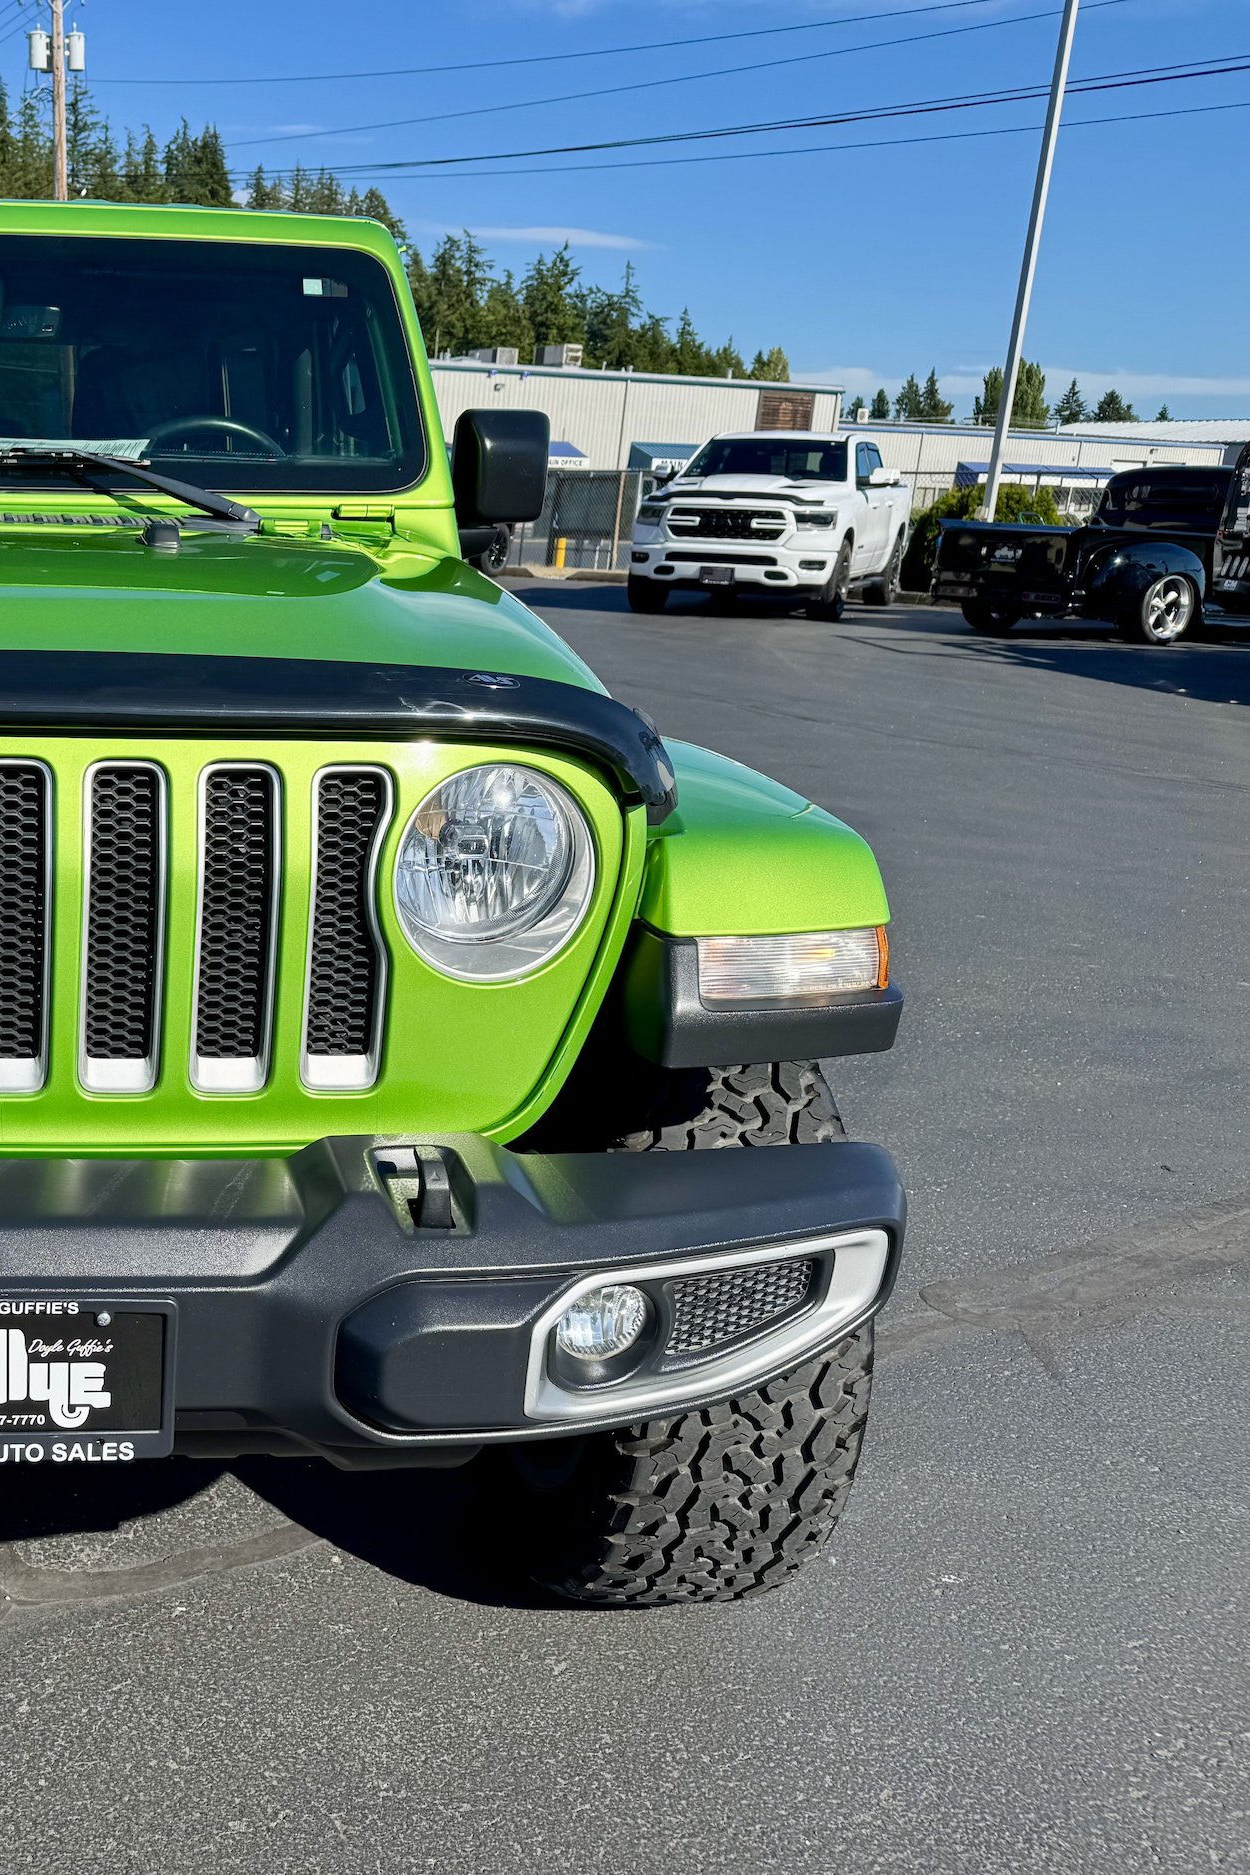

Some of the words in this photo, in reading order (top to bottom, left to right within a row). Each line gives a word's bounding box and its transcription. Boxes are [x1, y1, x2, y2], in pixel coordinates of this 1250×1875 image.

[28, 1338, 64, 1357] Doyle
[66, 1338, 114, 1357] Guffie's
[51, 1442, 135, 1462] SALES
